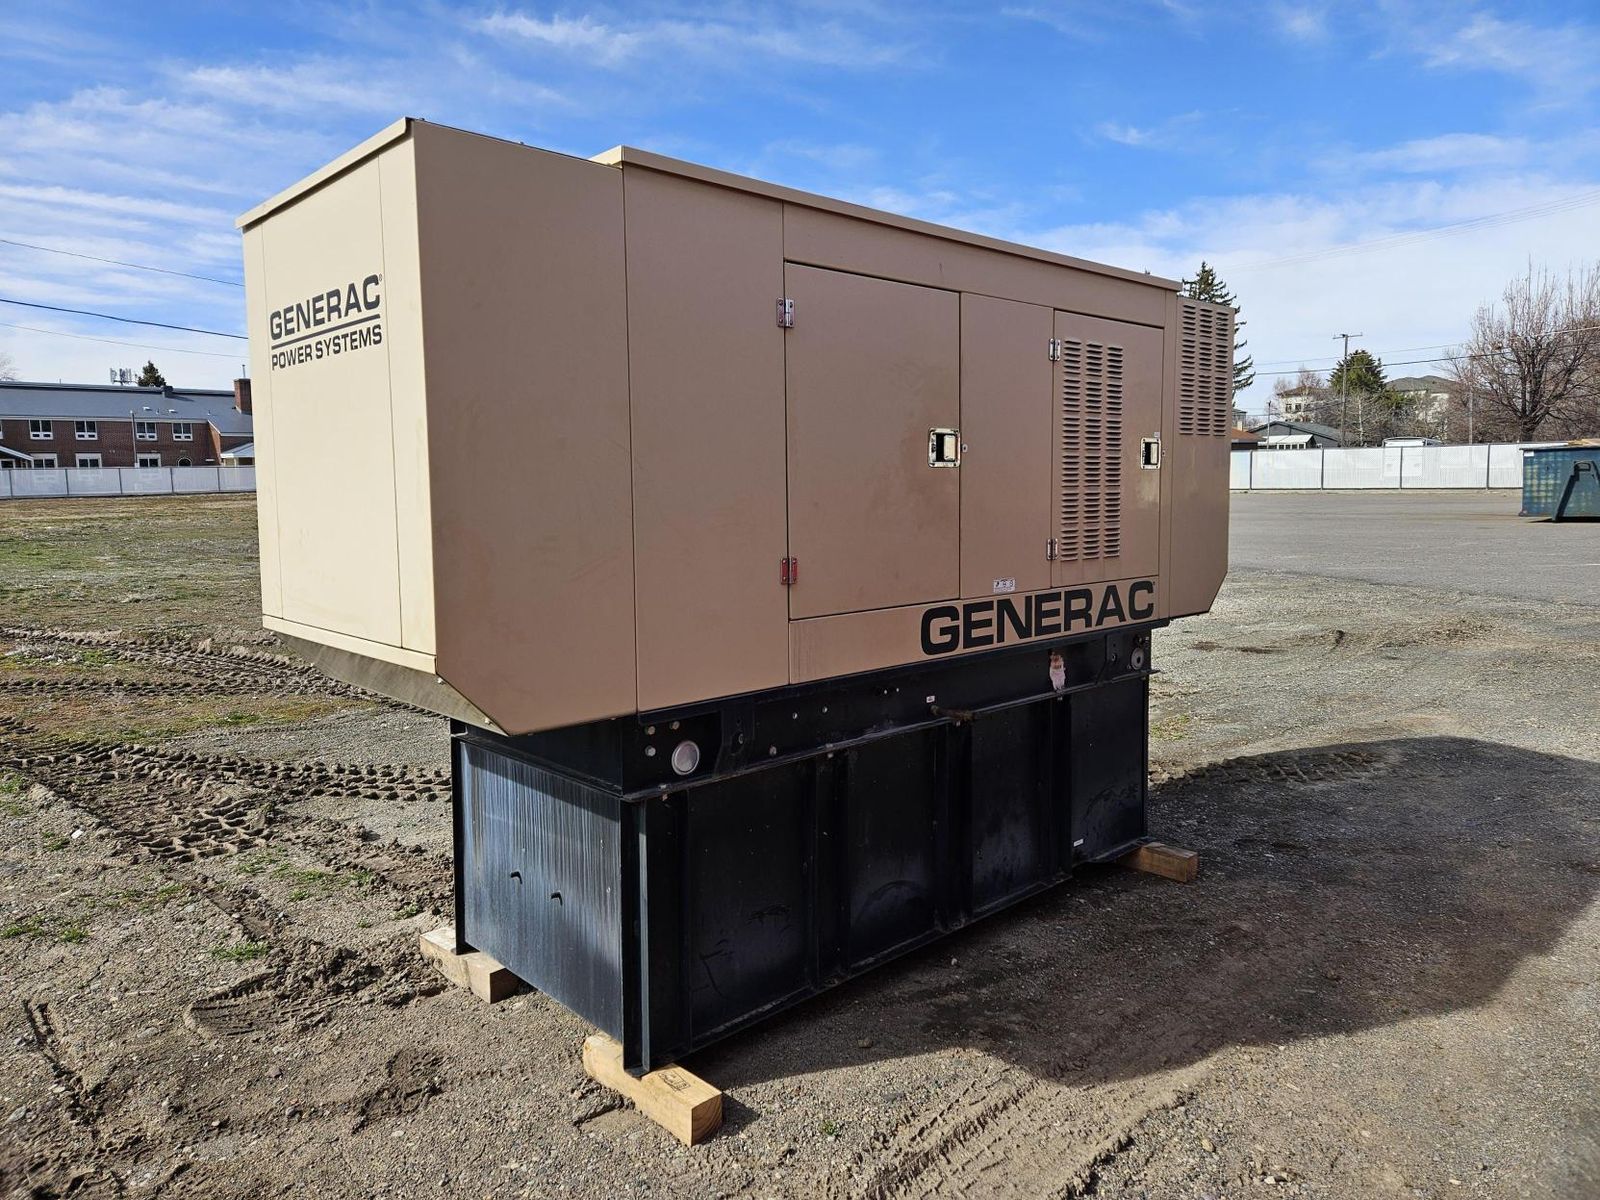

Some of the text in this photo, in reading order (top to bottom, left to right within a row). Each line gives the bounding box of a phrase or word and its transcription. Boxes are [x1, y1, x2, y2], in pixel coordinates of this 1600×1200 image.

[269, 274, 381, 340] GENERAC
[271, 324, 382, 371] POWER SYSTEMS
[920, 580, 1154, 656] GENERAC
